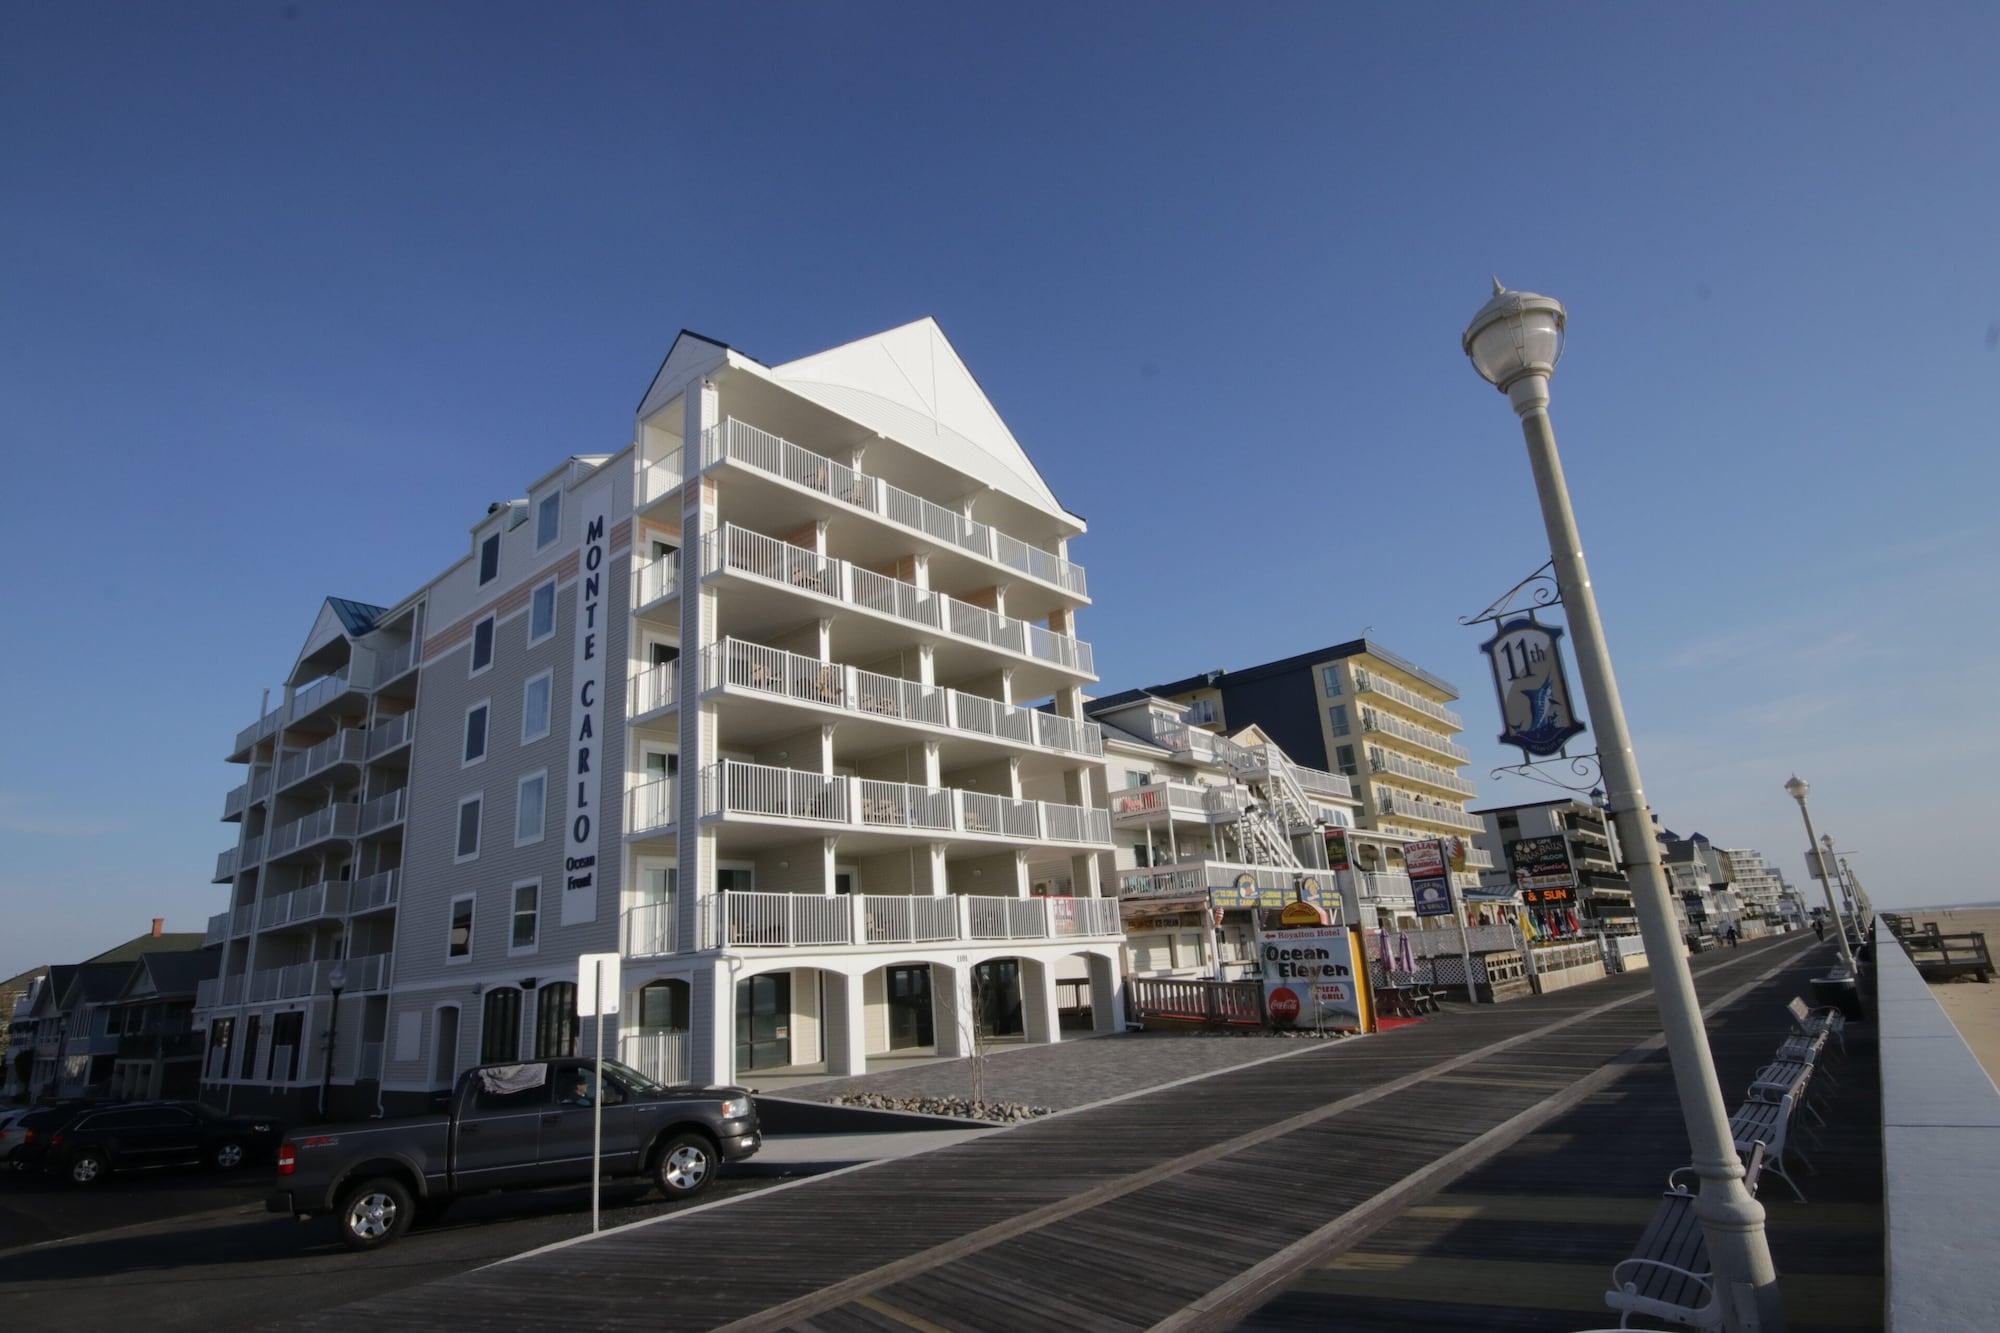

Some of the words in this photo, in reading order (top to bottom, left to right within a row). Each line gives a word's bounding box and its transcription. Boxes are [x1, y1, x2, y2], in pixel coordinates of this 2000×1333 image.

[584, 515, 603, 661] MONTE
[1501, 637, 1546, 681] 11th
[573, 680, 595, 843] CARLO
[1543, 889, 1567, 900] SUN
[1317, 929, 1340, 937] Hotel
[1266, 945, 1330, 961] Ocean
[1278, 962, 1349, 978] Eleven
[1322, 992, 1345, 1000] GRILL
